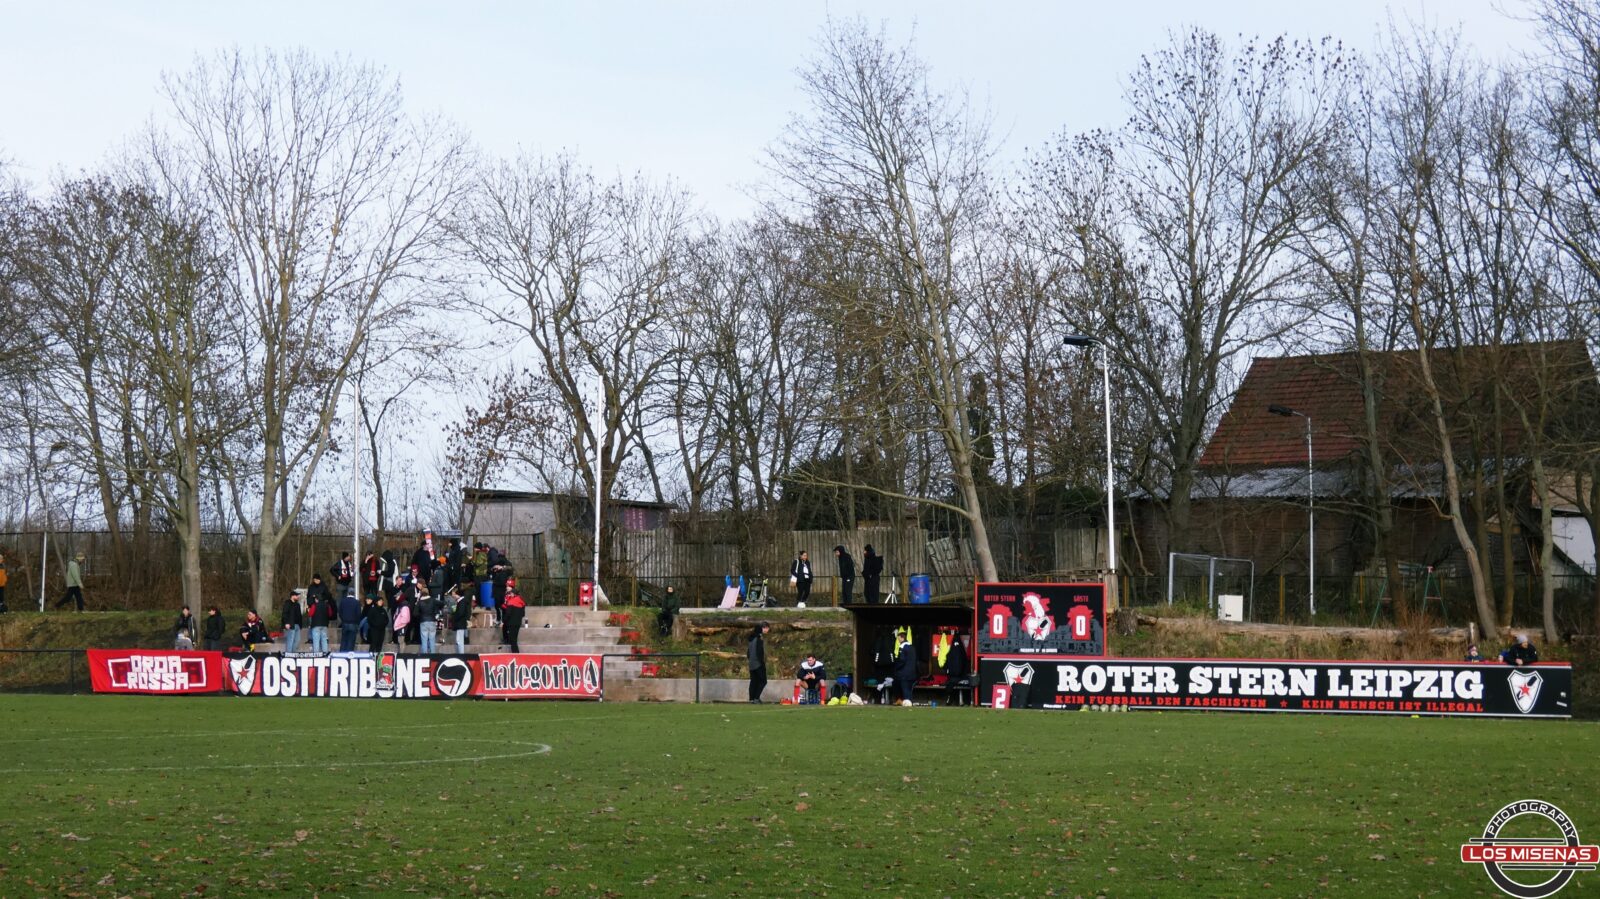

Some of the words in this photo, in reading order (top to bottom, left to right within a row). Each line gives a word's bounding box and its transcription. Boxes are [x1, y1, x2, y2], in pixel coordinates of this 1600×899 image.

[993, 614, 1003, 634] 0
[1076, 615, 1086, 636] 0
[127, 672, 189, 690] ROSSA
[263, 656, 431, 698] OSTTRIBNE
[483, 658, 581, 691] kategorie
[1057, 665, 1179, 693] ROTER
[1188, 666, 1317, 696] STERN
[1327, 669, 1484, 699] LEIPZIG
[995, 688, 1006, 708] 2
[1056, 695, 1085, 704] KEIN
[1089, 696, 1152, 705] FUSSBALL
[1157, 697, 1181, 705] DEN
[1186, 697, 1266, 708] FASCHISTEN
[1302, 700, 1334, 709] KEIN
[1339, 700, 1395, 710] MENSCH
[1399, 702, 1422, 711] IST
[1427, 702, 1484, 712] ILLEGAL
